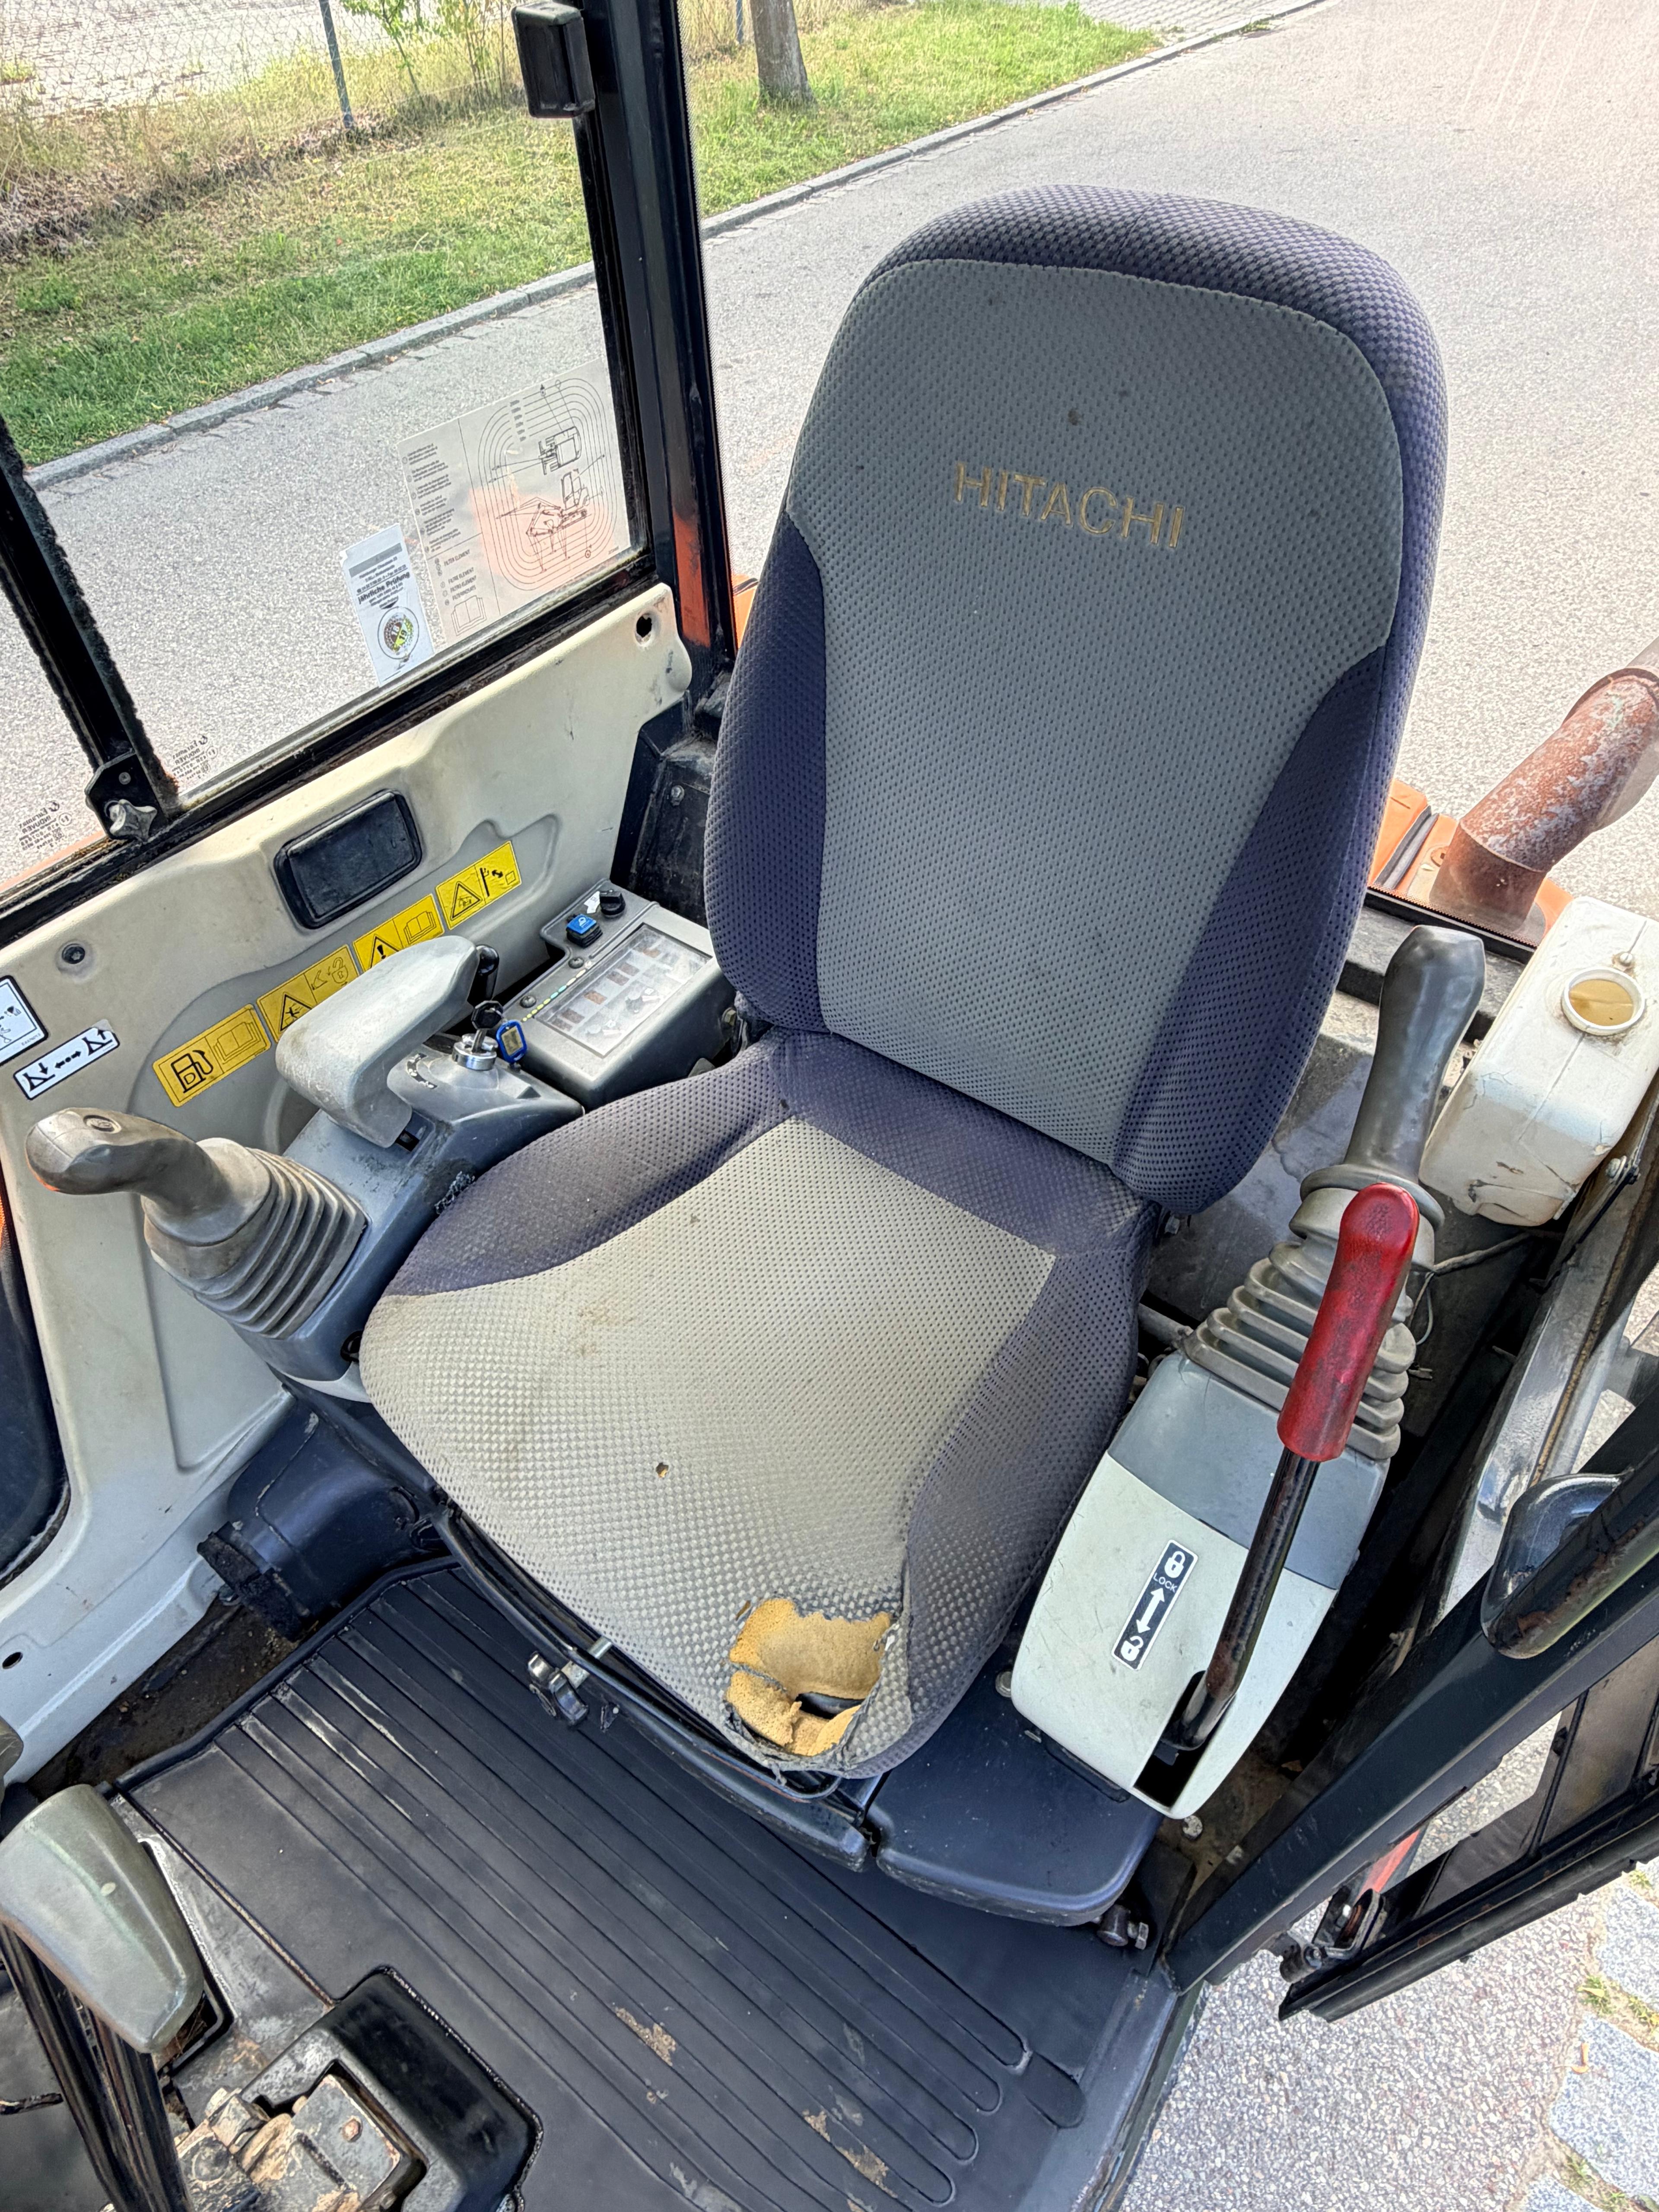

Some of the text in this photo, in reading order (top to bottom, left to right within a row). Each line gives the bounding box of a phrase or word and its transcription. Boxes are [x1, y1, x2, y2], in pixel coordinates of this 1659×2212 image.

[955, 462, 1184, 548] HITACHI
[399, 629, 407, 640] 19
[183, 1072, 196, 1085] D
[1153, 1573, 1178, 1592] LOCK
